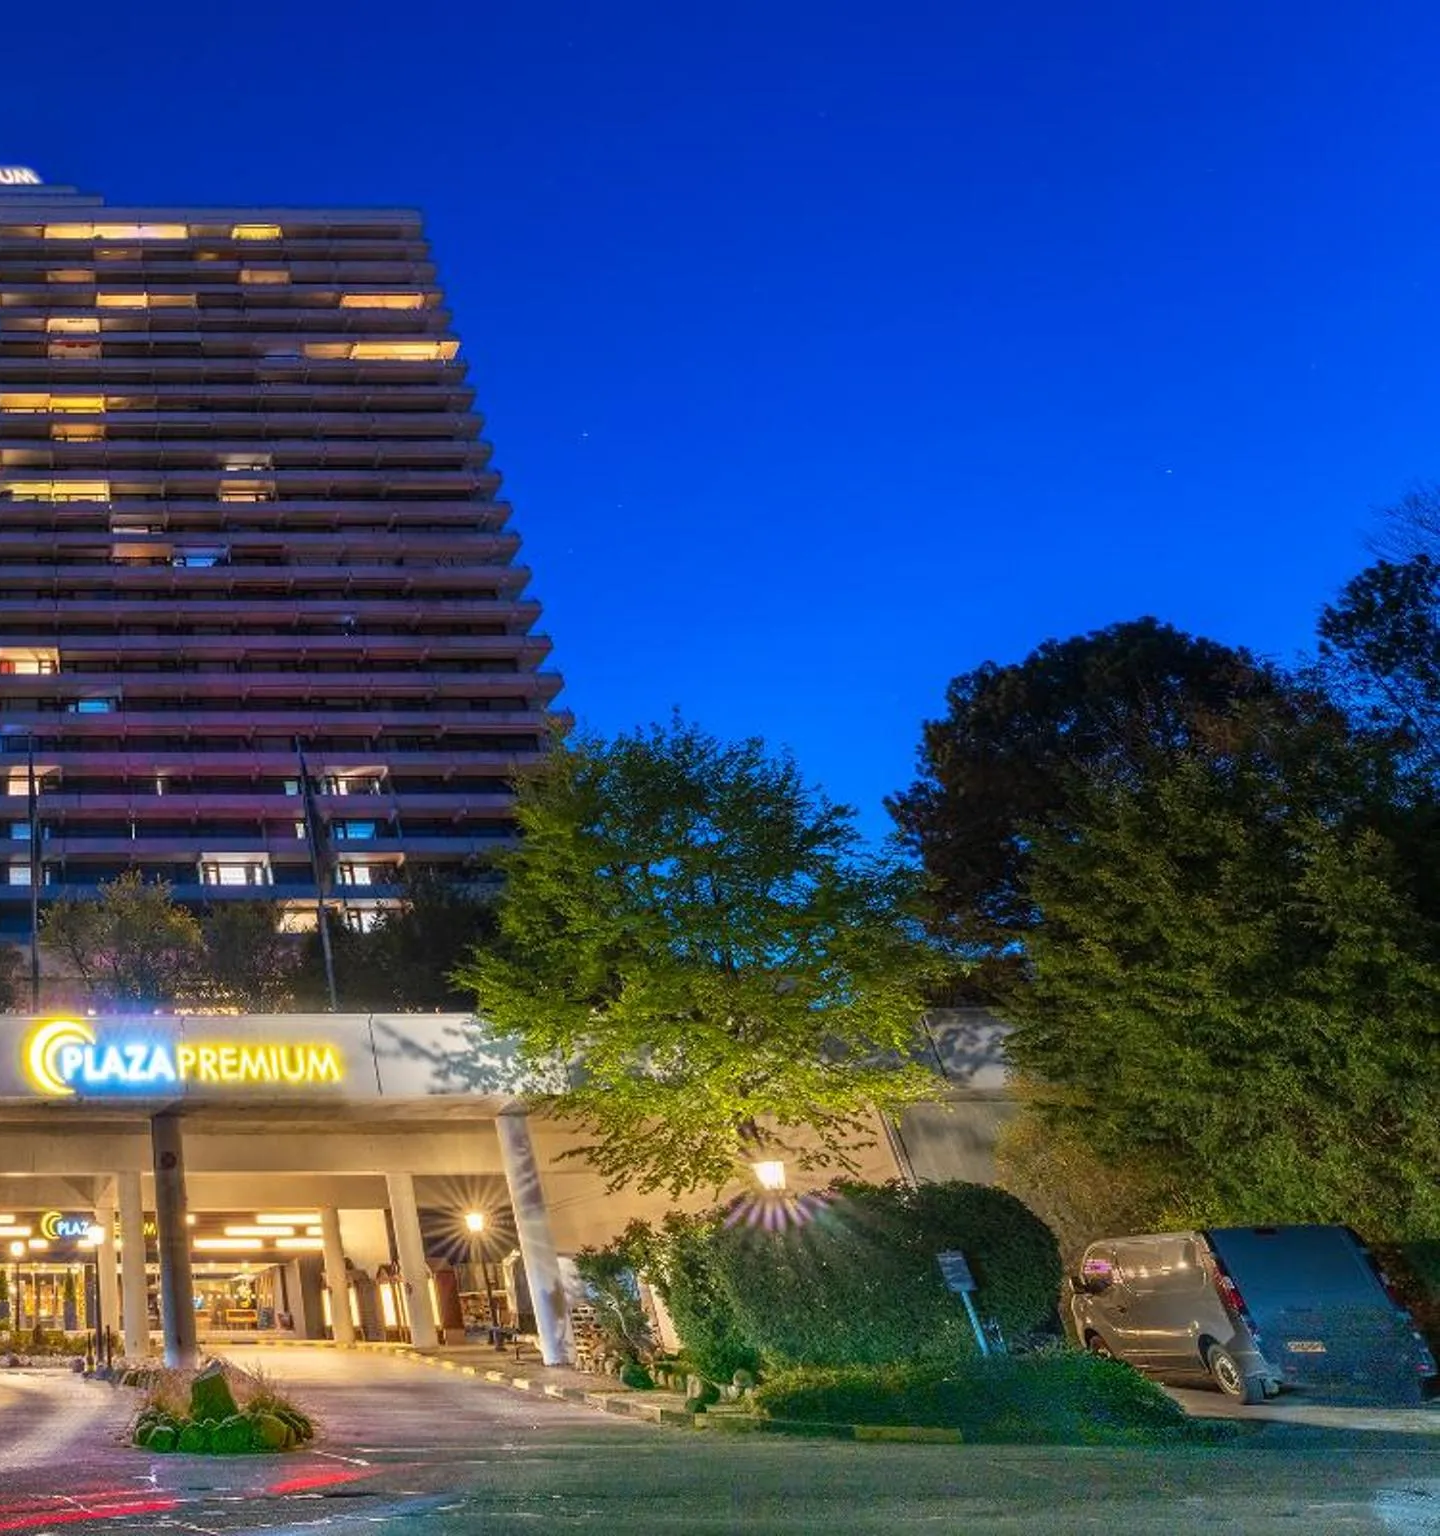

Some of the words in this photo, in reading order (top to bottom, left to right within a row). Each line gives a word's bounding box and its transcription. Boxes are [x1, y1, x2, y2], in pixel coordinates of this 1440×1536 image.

[60, 1045, 176, 1081] PLAZA
[177, 1046, 341, 1082] PREMIUM
[57, 1221, 90, 1236] PLAZ
